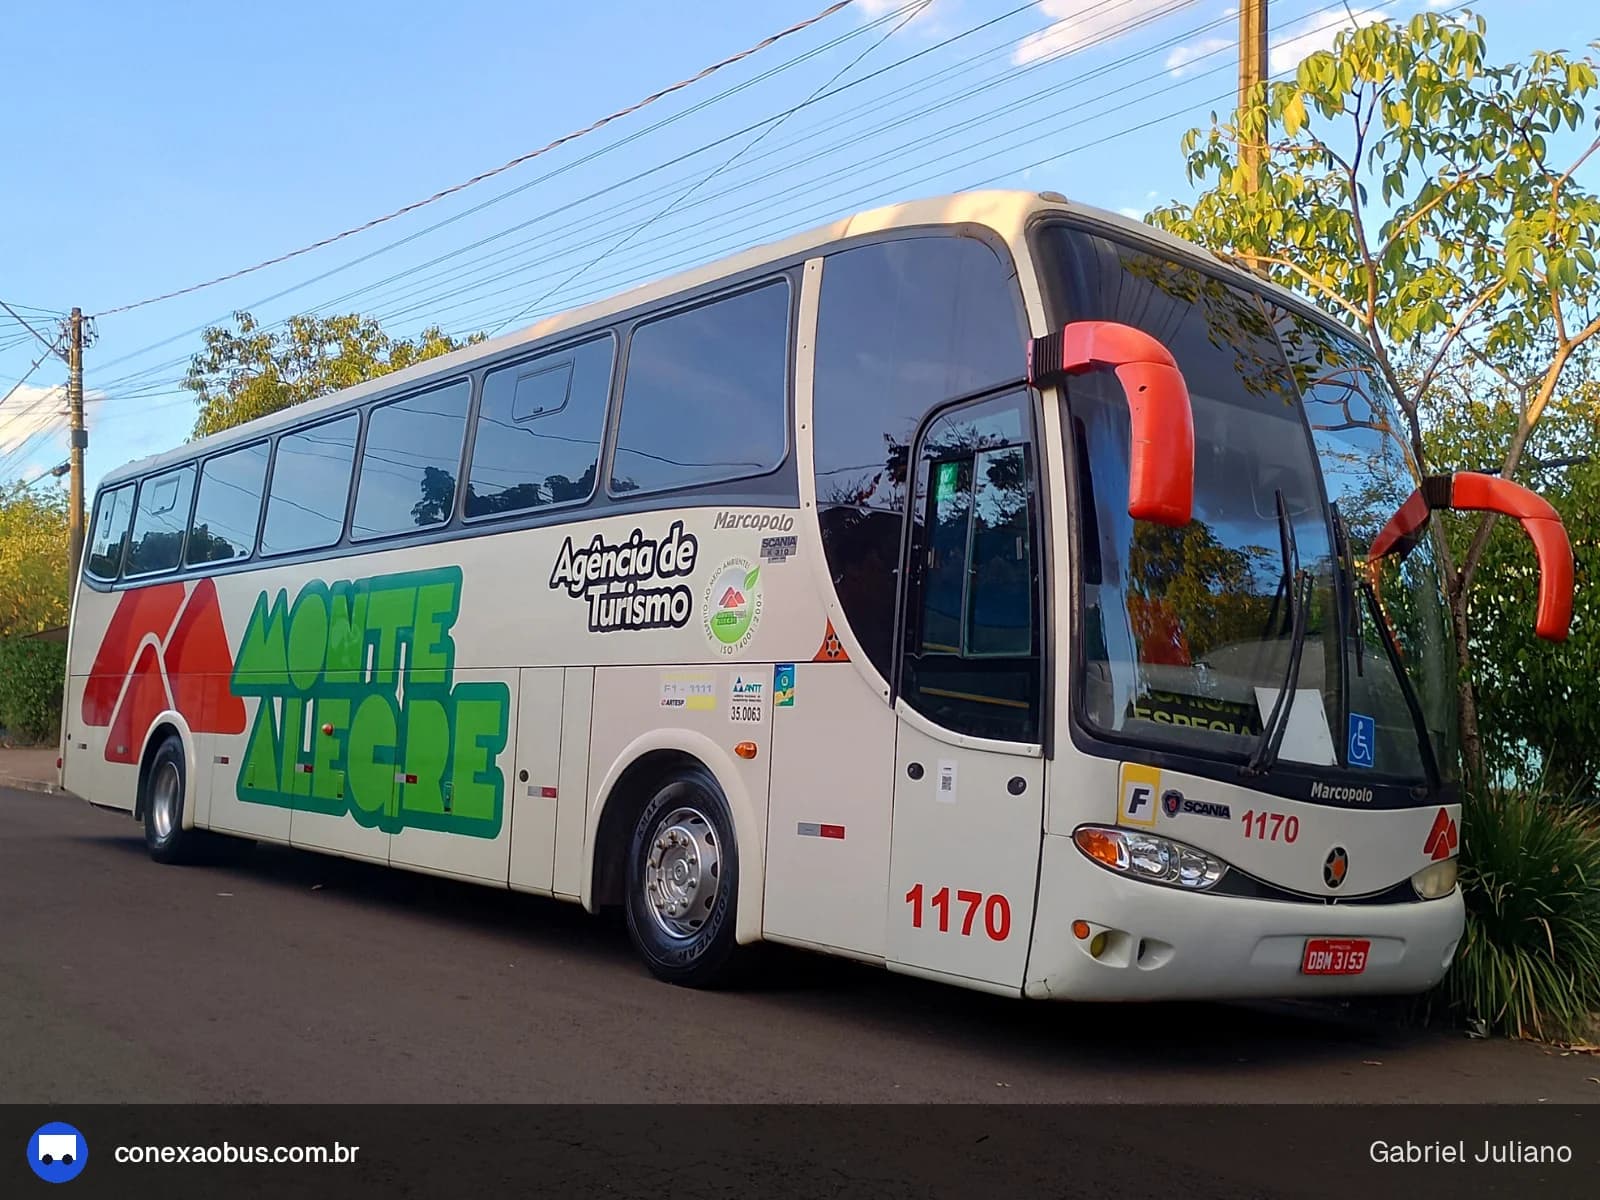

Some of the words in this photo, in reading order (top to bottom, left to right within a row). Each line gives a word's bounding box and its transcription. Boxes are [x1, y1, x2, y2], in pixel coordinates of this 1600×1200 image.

[712, 511, 794, 531] Marcopolo
[762, 536, 797, 548] SCANIA
[550, 533, 655, 591] Agência
[658, 525, 695, 574] de
[587, 582, 690, 628] Turismo
[232, 570, 460, 693] MONTE
[720, 645, 733, 655] ISO
[744, 684, 763, 693] ANTT
[731, 706, 761, 721] 35.0063
[237, 688, 505, 832] ALEGRE
[1128, 788, 1150, 814] F
[1310, 780, 1374, 803] Marcopolo
[1183, 801, 1231, 819] SCANIA
[1241, 809, 1300, 843] 1170
[905, 883, 1011, 941] 1170
[1307, 951, 1333, 970] DBM
[1334, 951, 1365, 970] 3153
